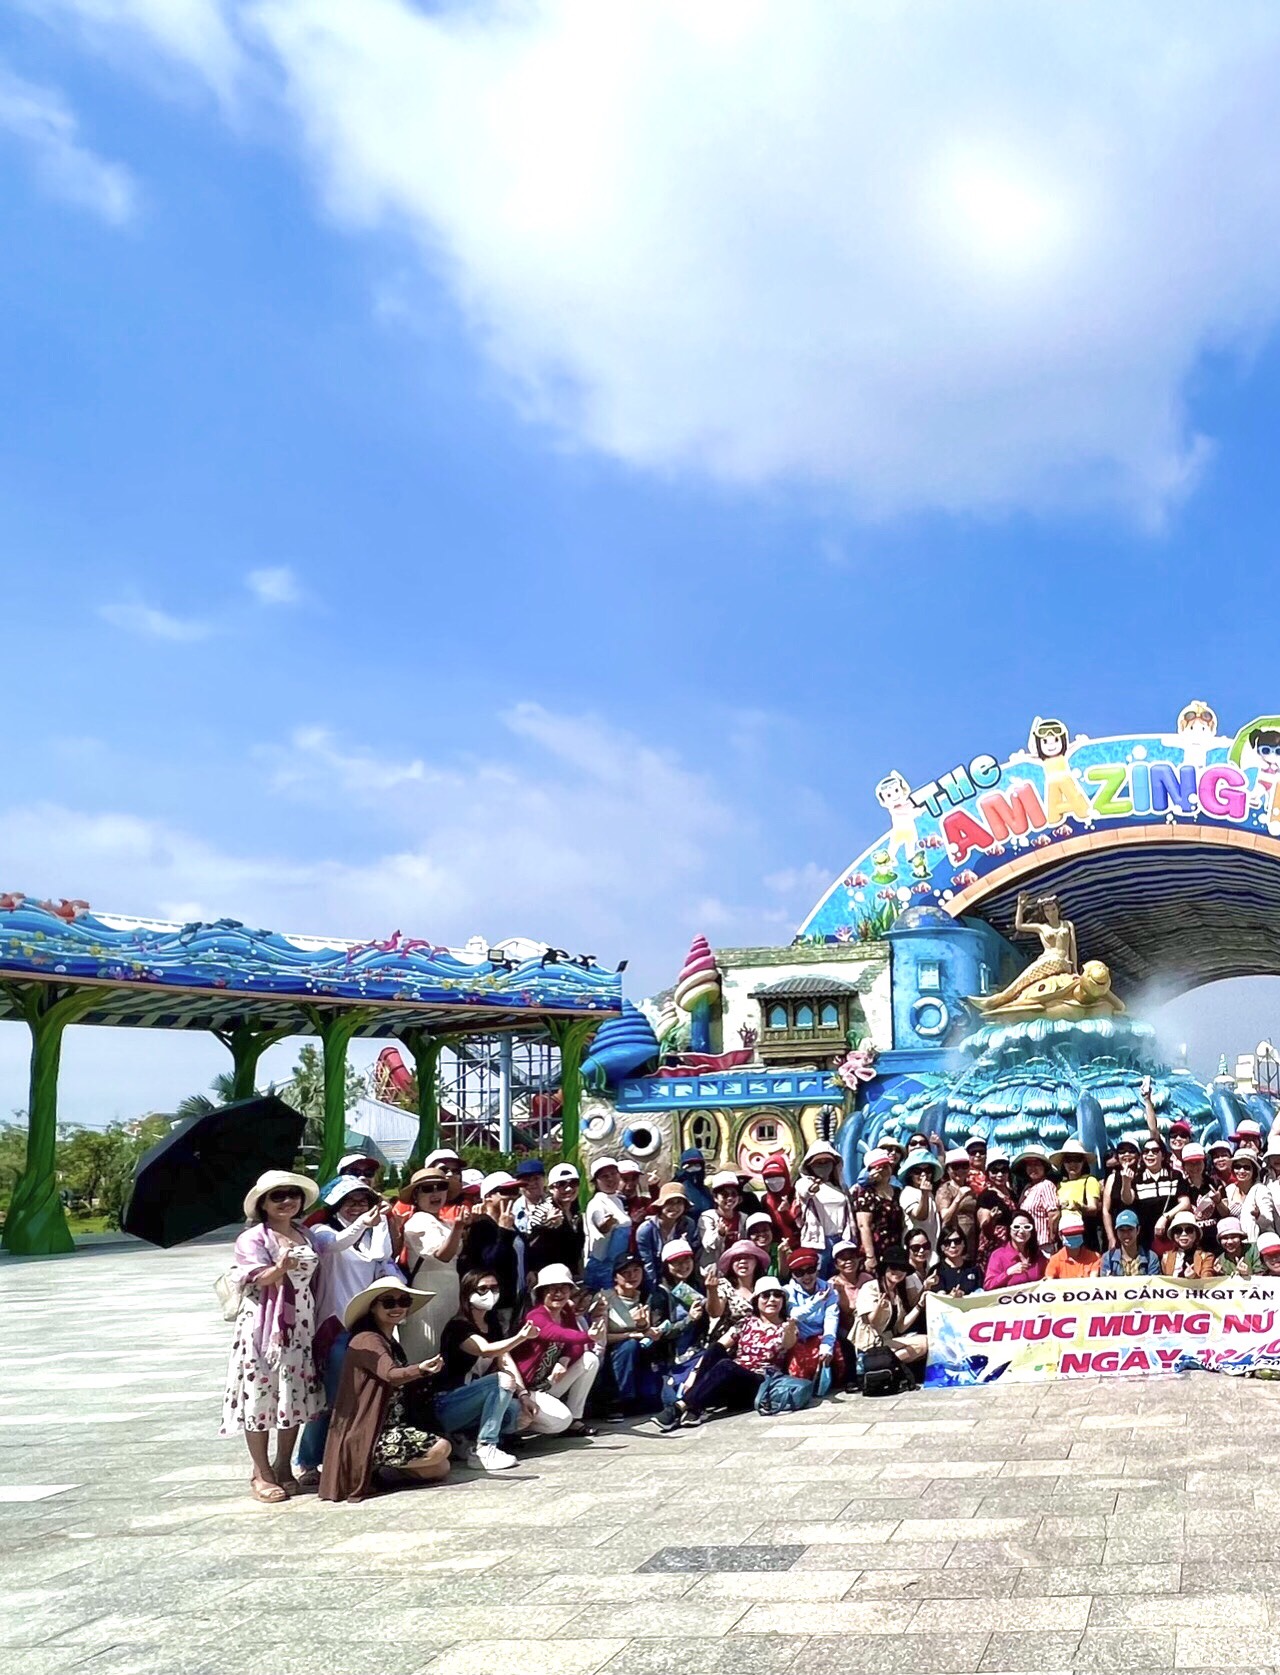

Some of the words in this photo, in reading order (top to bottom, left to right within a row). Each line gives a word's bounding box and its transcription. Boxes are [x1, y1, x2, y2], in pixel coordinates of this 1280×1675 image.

[943, 764, 1247, 863] AMAZING
[998, 1291, 1056, 1305] CÔNG
[1063, 1288, 1117, 1302] ĐOÀN
[1124, 1285, 1179, 1299] CẢNG
[1186, 1289, 1234, 1300] HKQT
[968, 1315, 1077, 1343] CHÚC
[1088, 1310, 1211, 1337] MỪNG
[1060, 1347, 1183, 1374] NGÀY
